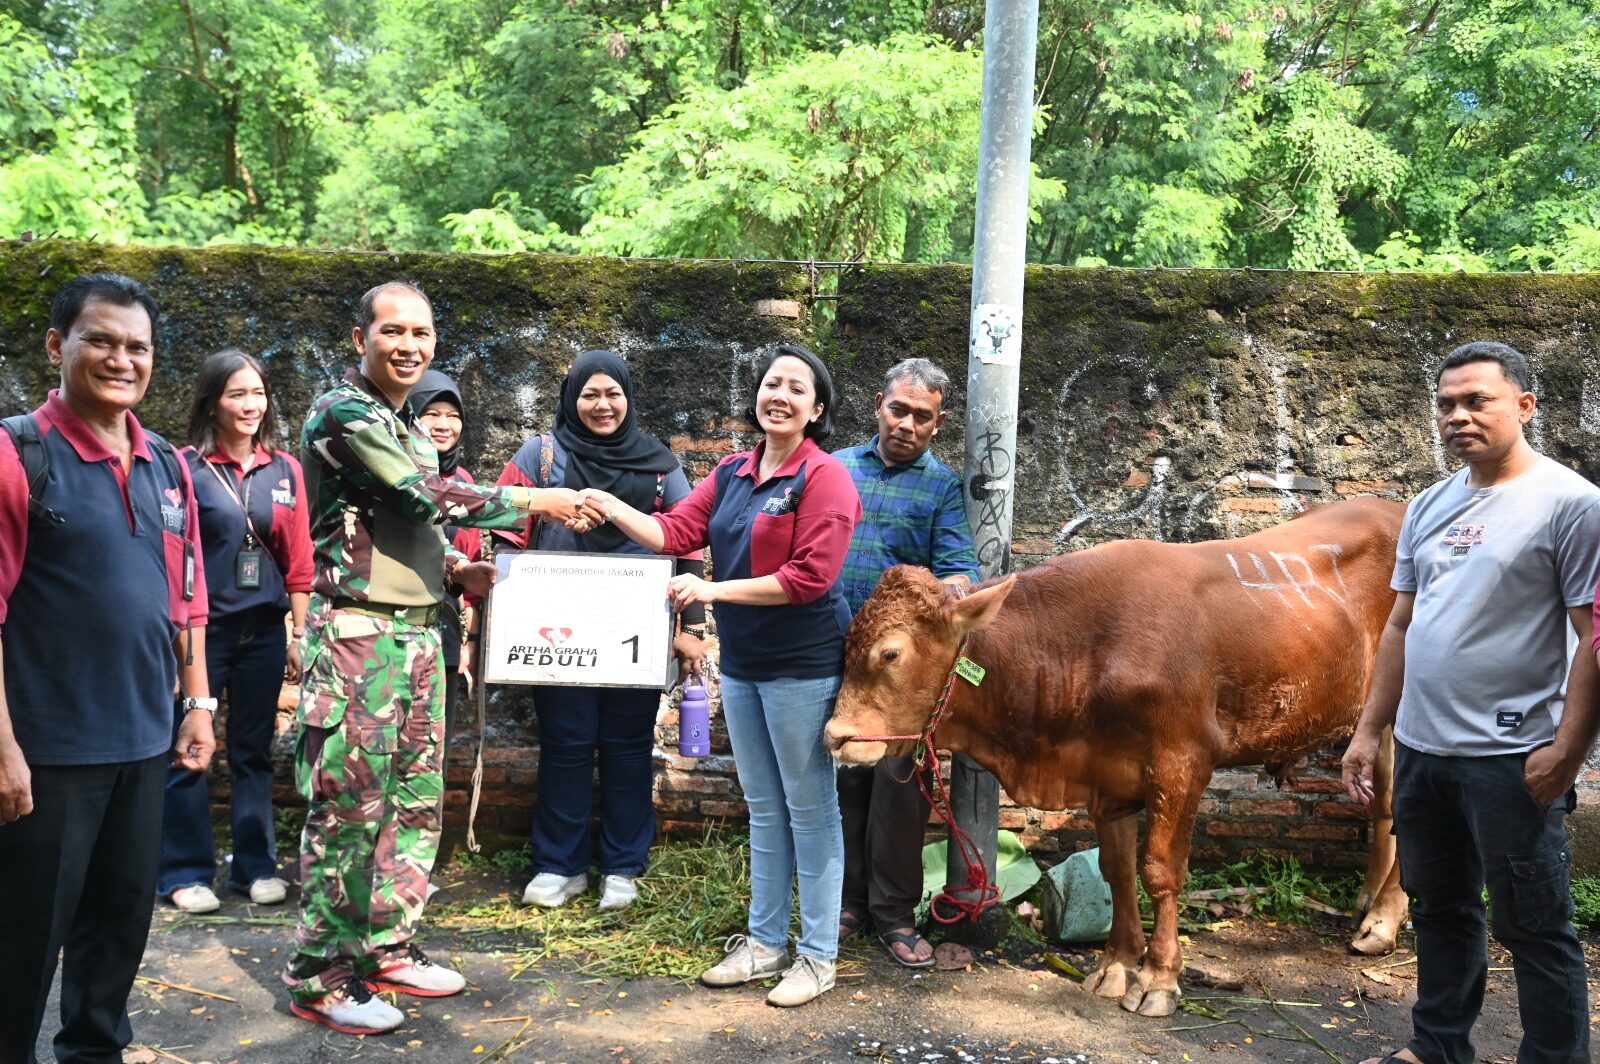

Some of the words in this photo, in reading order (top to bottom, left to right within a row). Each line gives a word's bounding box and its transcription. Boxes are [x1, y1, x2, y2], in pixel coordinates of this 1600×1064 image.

[1444, 524, 1486, 546] 501
[520, 566, 546, 574] HOTEL
[550, 567, 605, 576] BOROBUDUR
[608, 568, 644, 577] JAKARTA
[509, 645, 551, 654] ARTHA
[554, 647, 598, 656] GRAHA
[621, 635, 639, 664] 1
[506, 653, 598, 667] PEDULI
